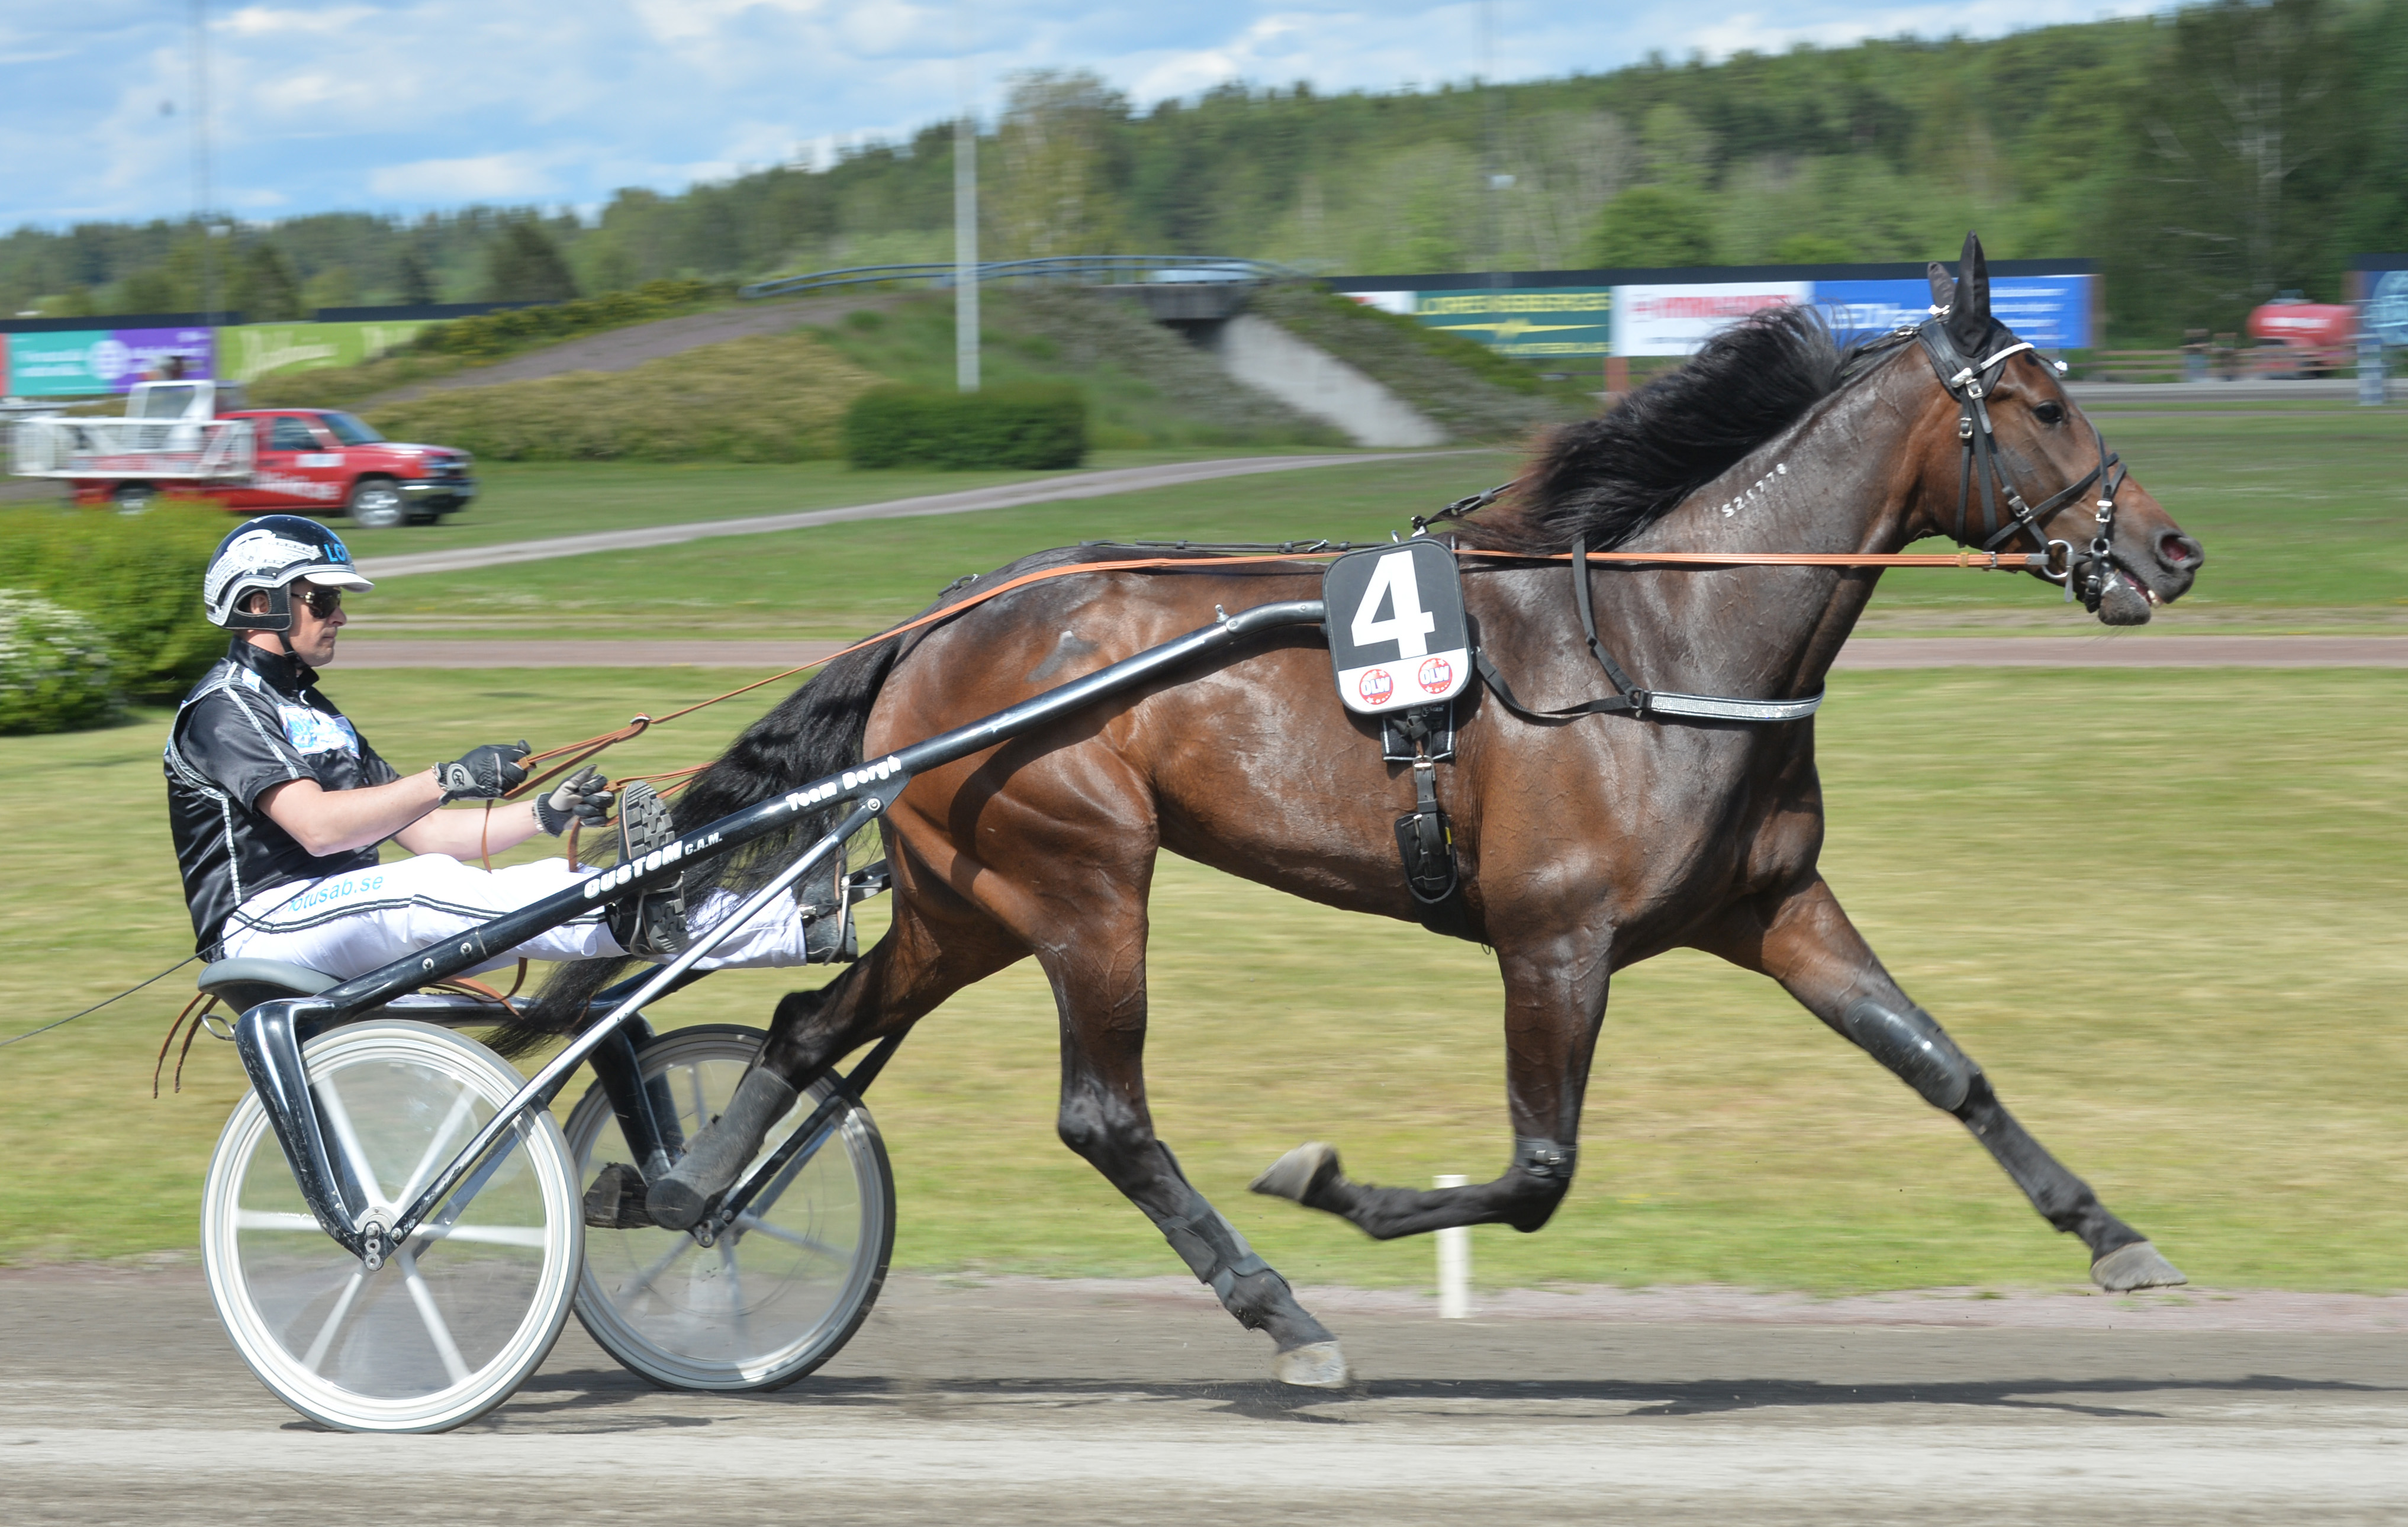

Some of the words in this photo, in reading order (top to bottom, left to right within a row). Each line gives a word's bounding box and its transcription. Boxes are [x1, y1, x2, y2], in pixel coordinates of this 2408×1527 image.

[1351, 550, 1435, 659] 4
[1361, 676, 1391, 696] OLW
[1419, 665, 1450, 685] OLW
[785, 781, 838, 811] Team
[584, 840, 683, 899] CUSTOM
[685, 832, 723, 855] C.A.M.
